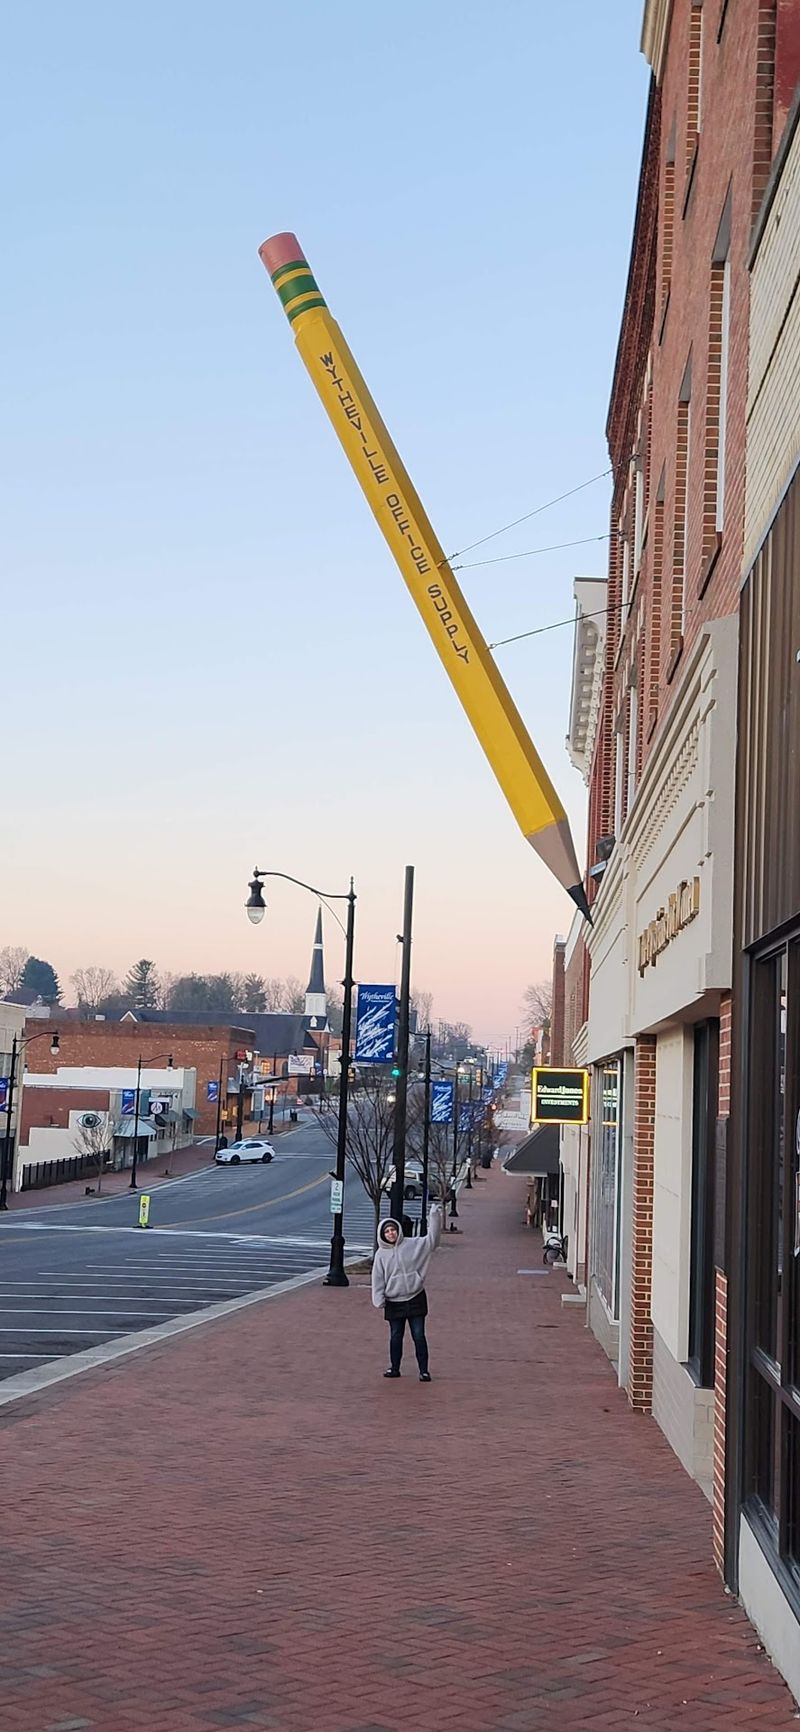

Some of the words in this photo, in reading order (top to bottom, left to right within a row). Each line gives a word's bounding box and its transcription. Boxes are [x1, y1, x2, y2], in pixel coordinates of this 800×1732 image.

[320, 351, 389, 484] WYTHEVILLE
[386, 493, 431, 574] OFFICE
[427, 584, 470, 664] SUPPLY
[360, 990, 394, 1003] Wytheville
